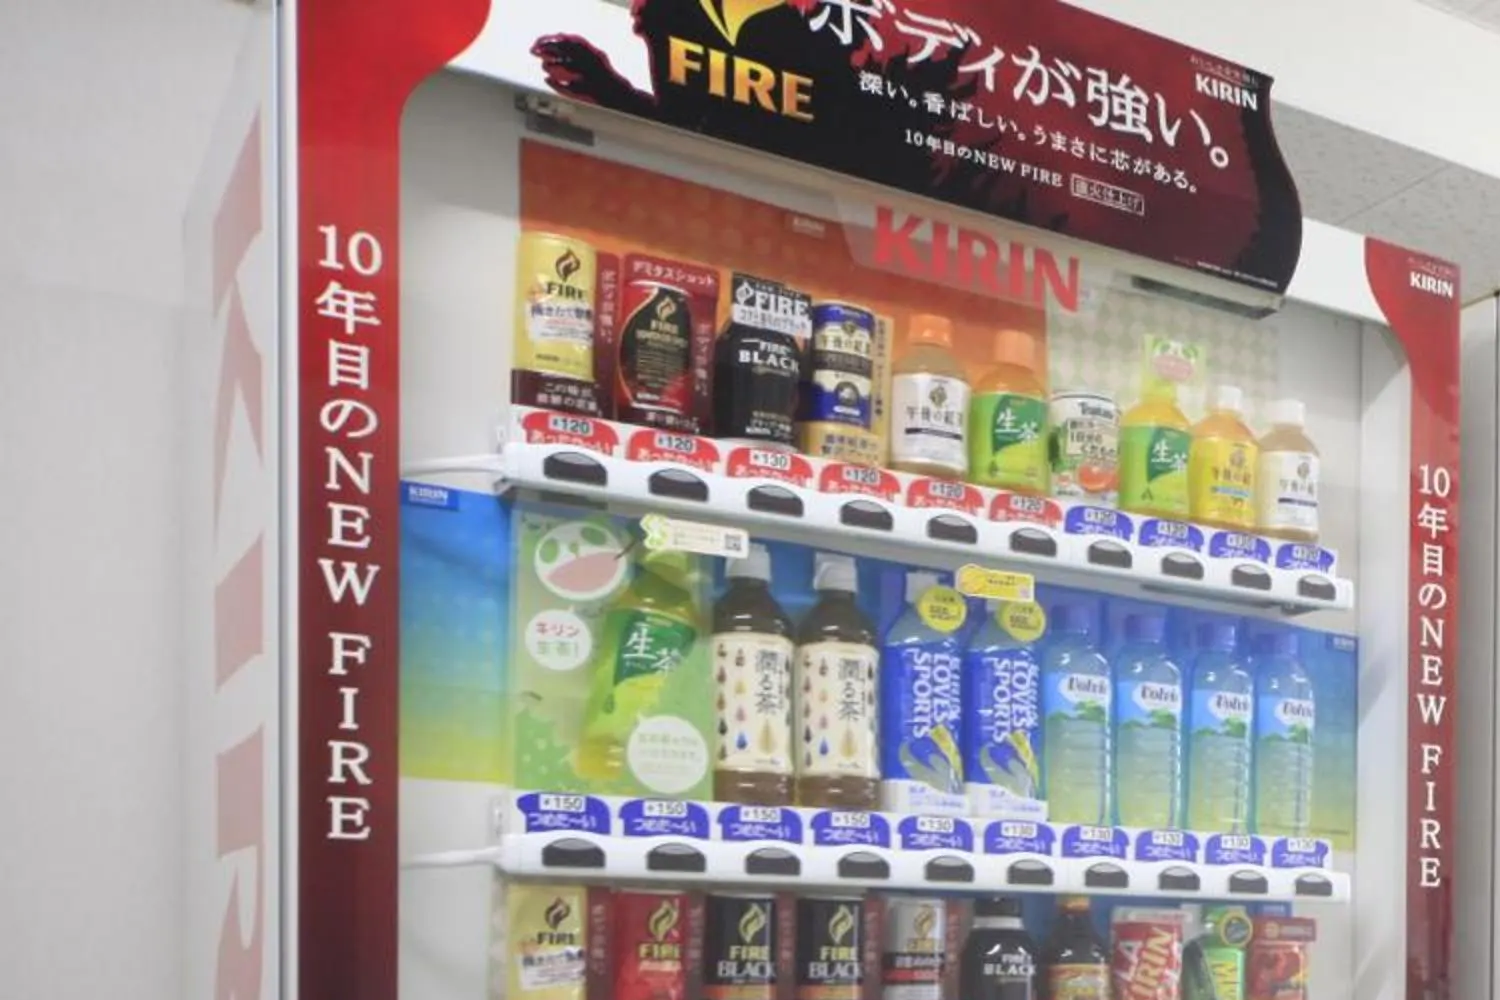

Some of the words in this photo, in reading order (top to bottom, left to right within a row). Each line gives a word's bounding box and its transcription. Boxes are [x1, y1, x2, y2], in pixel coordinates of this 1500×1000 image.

[668, 36, 815, 122] FIRE
[1195, 72, 1258, 112] KIRIN
[1020, 163, 1065, 188] FIRE
[873, 203, 1084, 314] KIRIN
[1410, 270, 1454, 300] KIRIN
[754, 290, 810, 320] FIRE
[622, 624, 684, 678] 生茶
[325, 631, 373, 842] FIRE
[1420, 743, 1444, 888] FIRE
